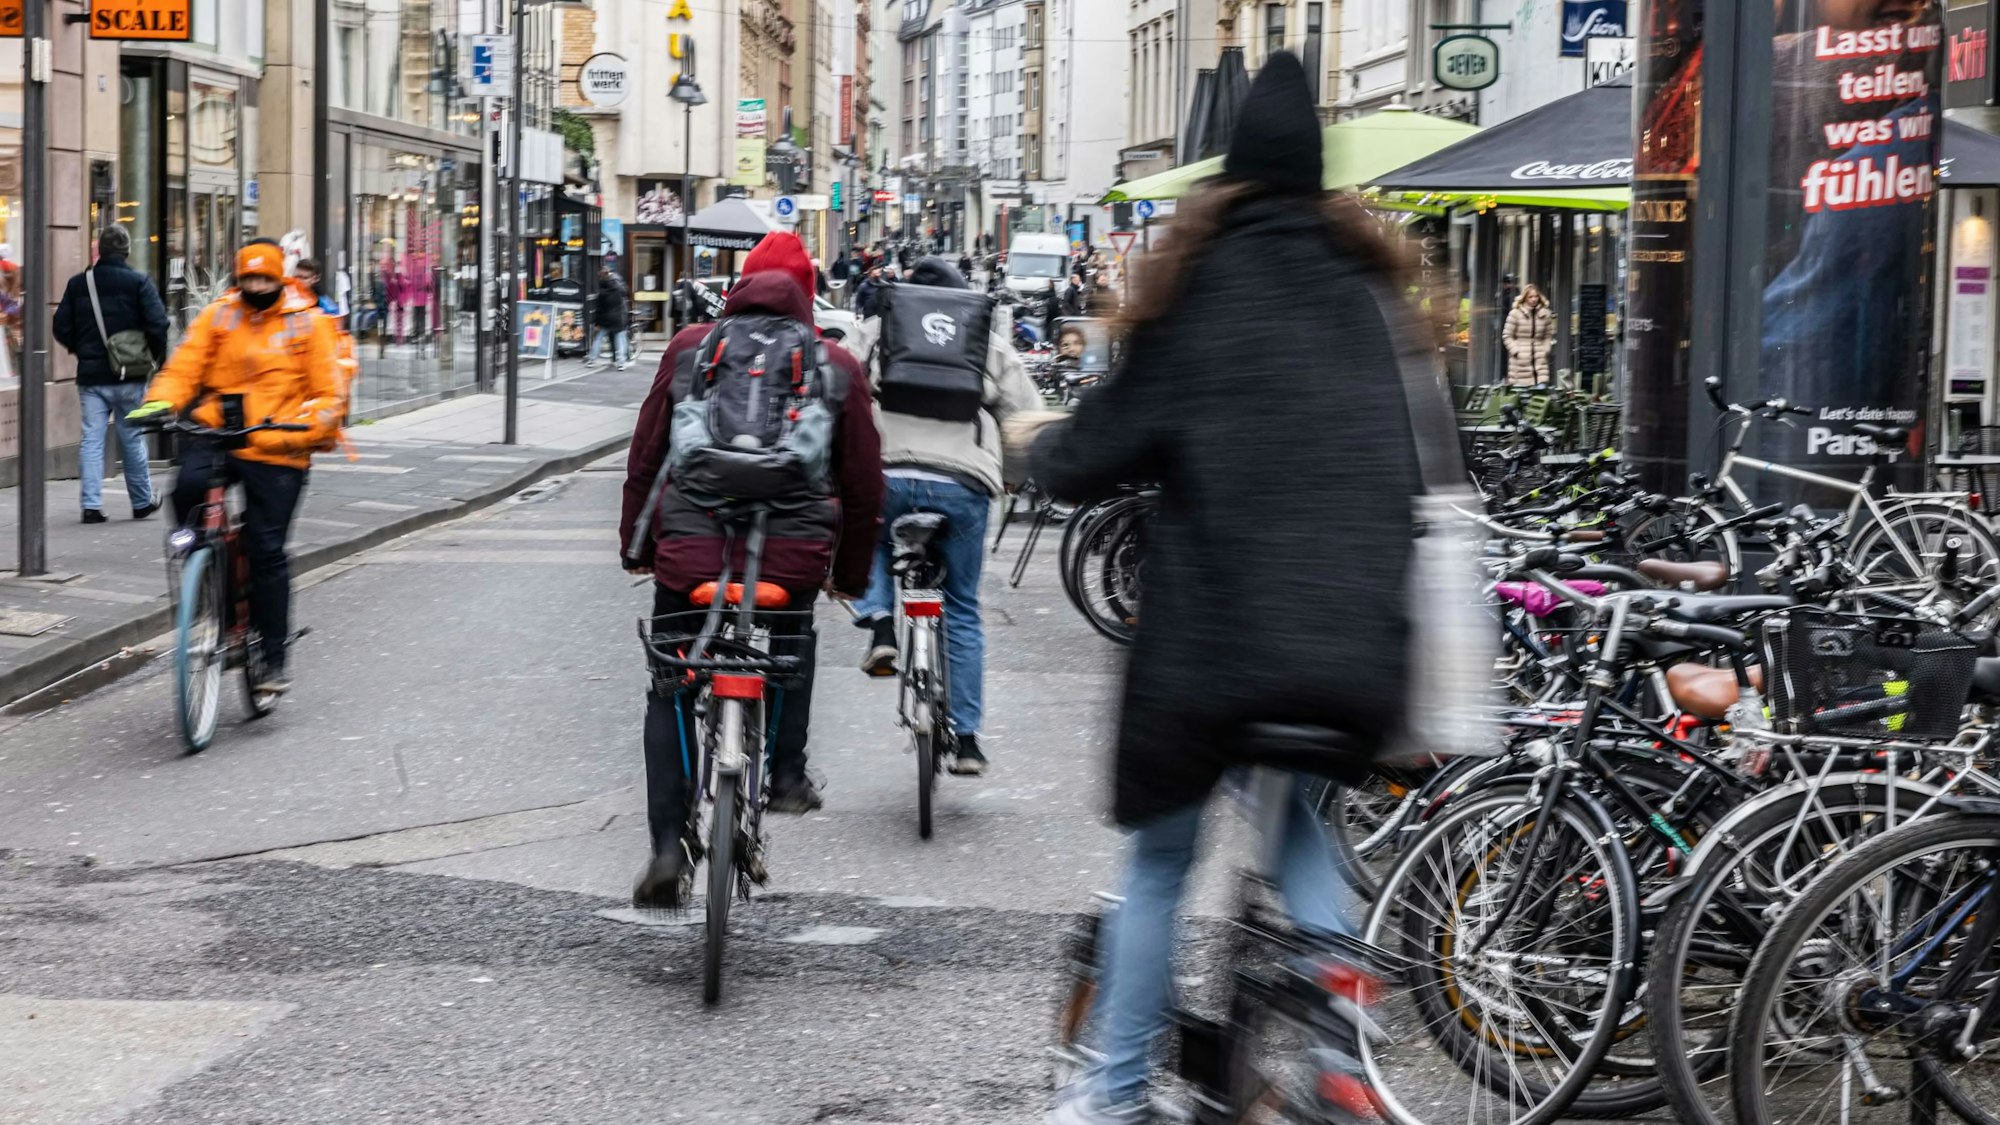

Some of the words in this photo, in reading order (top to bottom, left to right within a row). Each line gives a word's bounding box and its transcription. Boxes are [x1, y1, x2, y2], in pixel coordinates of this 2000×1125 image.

[95, 9, 185, 32] SCALE
[1562, 7, 1624, 43] Sion
[1815, 23, 1904, 59] Lasst
[587, 68, 626, 80] fritten
[1446, 53, 1487, 76] JEVER
[591, 79, 622, 90] werk
[1838, 64, 1929, 100] teilen,
[1824, 117, 1894, 147] was
[1898, 106, 1934, 140] wir
[687, 233, 756, 249] frittenwerk
[1818, 406, 1855, 421] Let's
[1855, 406, 1885, 421] date
